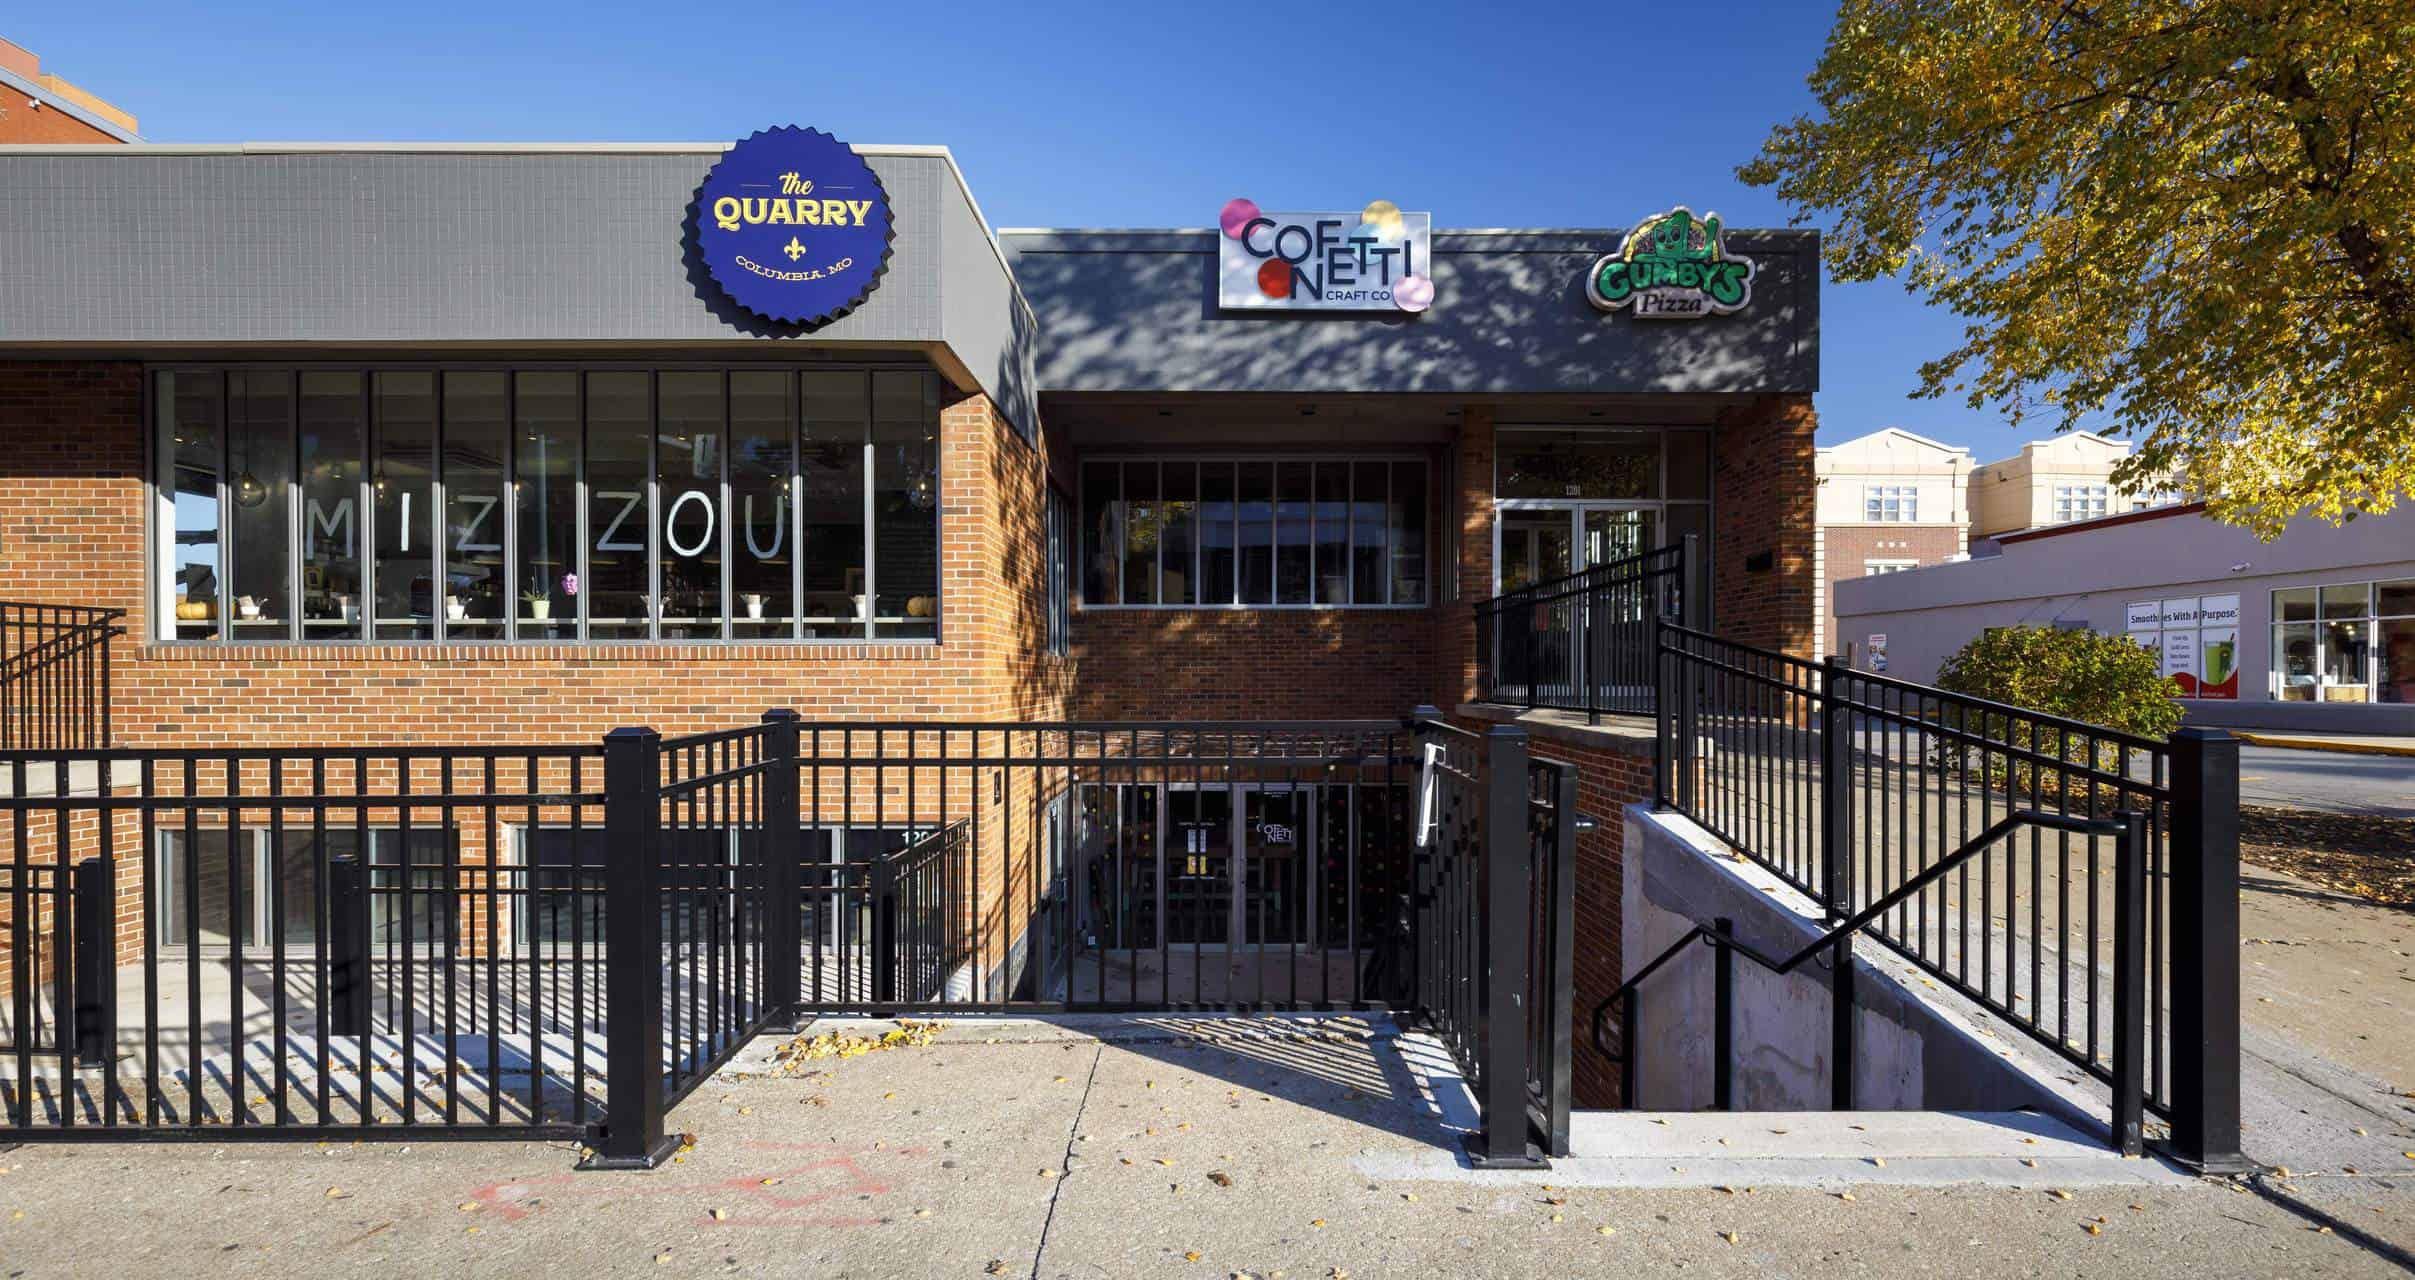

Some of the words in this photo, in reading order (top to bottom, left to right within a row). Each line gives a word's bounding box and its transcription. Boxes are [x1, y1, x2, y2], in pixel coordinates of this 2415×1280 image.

[779, 172, 813, 195] the
[714, 197, 872, 231] QUARRY
[828, 257, 852, 275] MO
[1600, 261, 1748, 304] GUMBY'S
[1327, 290, 1368, 301] CRAFT
[1372, 290, 1390, 301] CO
[1640, 294, 1701, 312] Pizza
[2173, 610, 2191, 621] With
[2192, 610, 2199, 620] A
